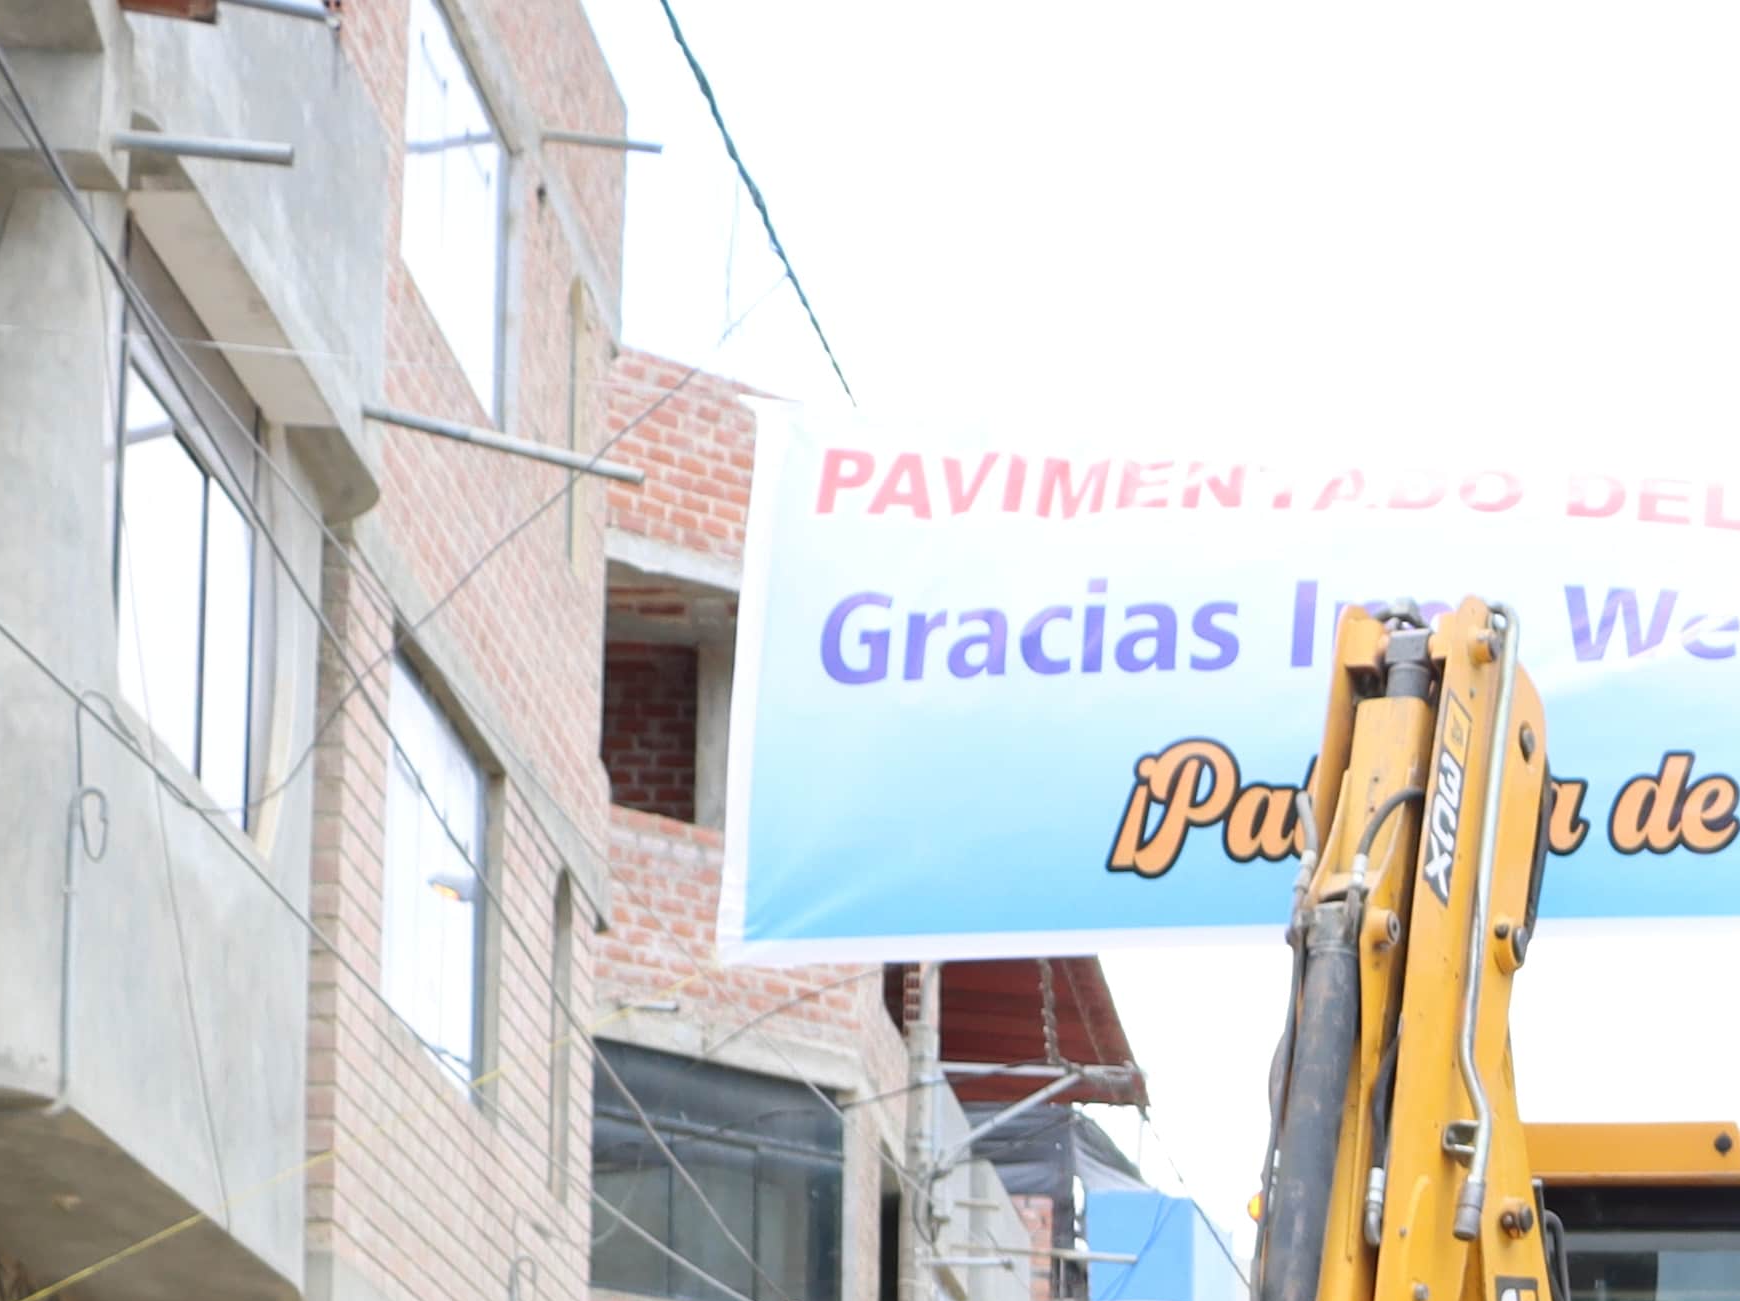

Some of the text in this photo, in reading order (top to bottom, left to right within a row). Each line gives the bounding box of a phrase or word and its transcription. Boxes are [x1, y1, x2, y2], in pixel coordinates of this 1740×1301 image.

[815, 447, 1524, 520] PAVIMENTADO
[819, 577, 1241, 686] Gracias
[1607, 751, 1740, 856] de
